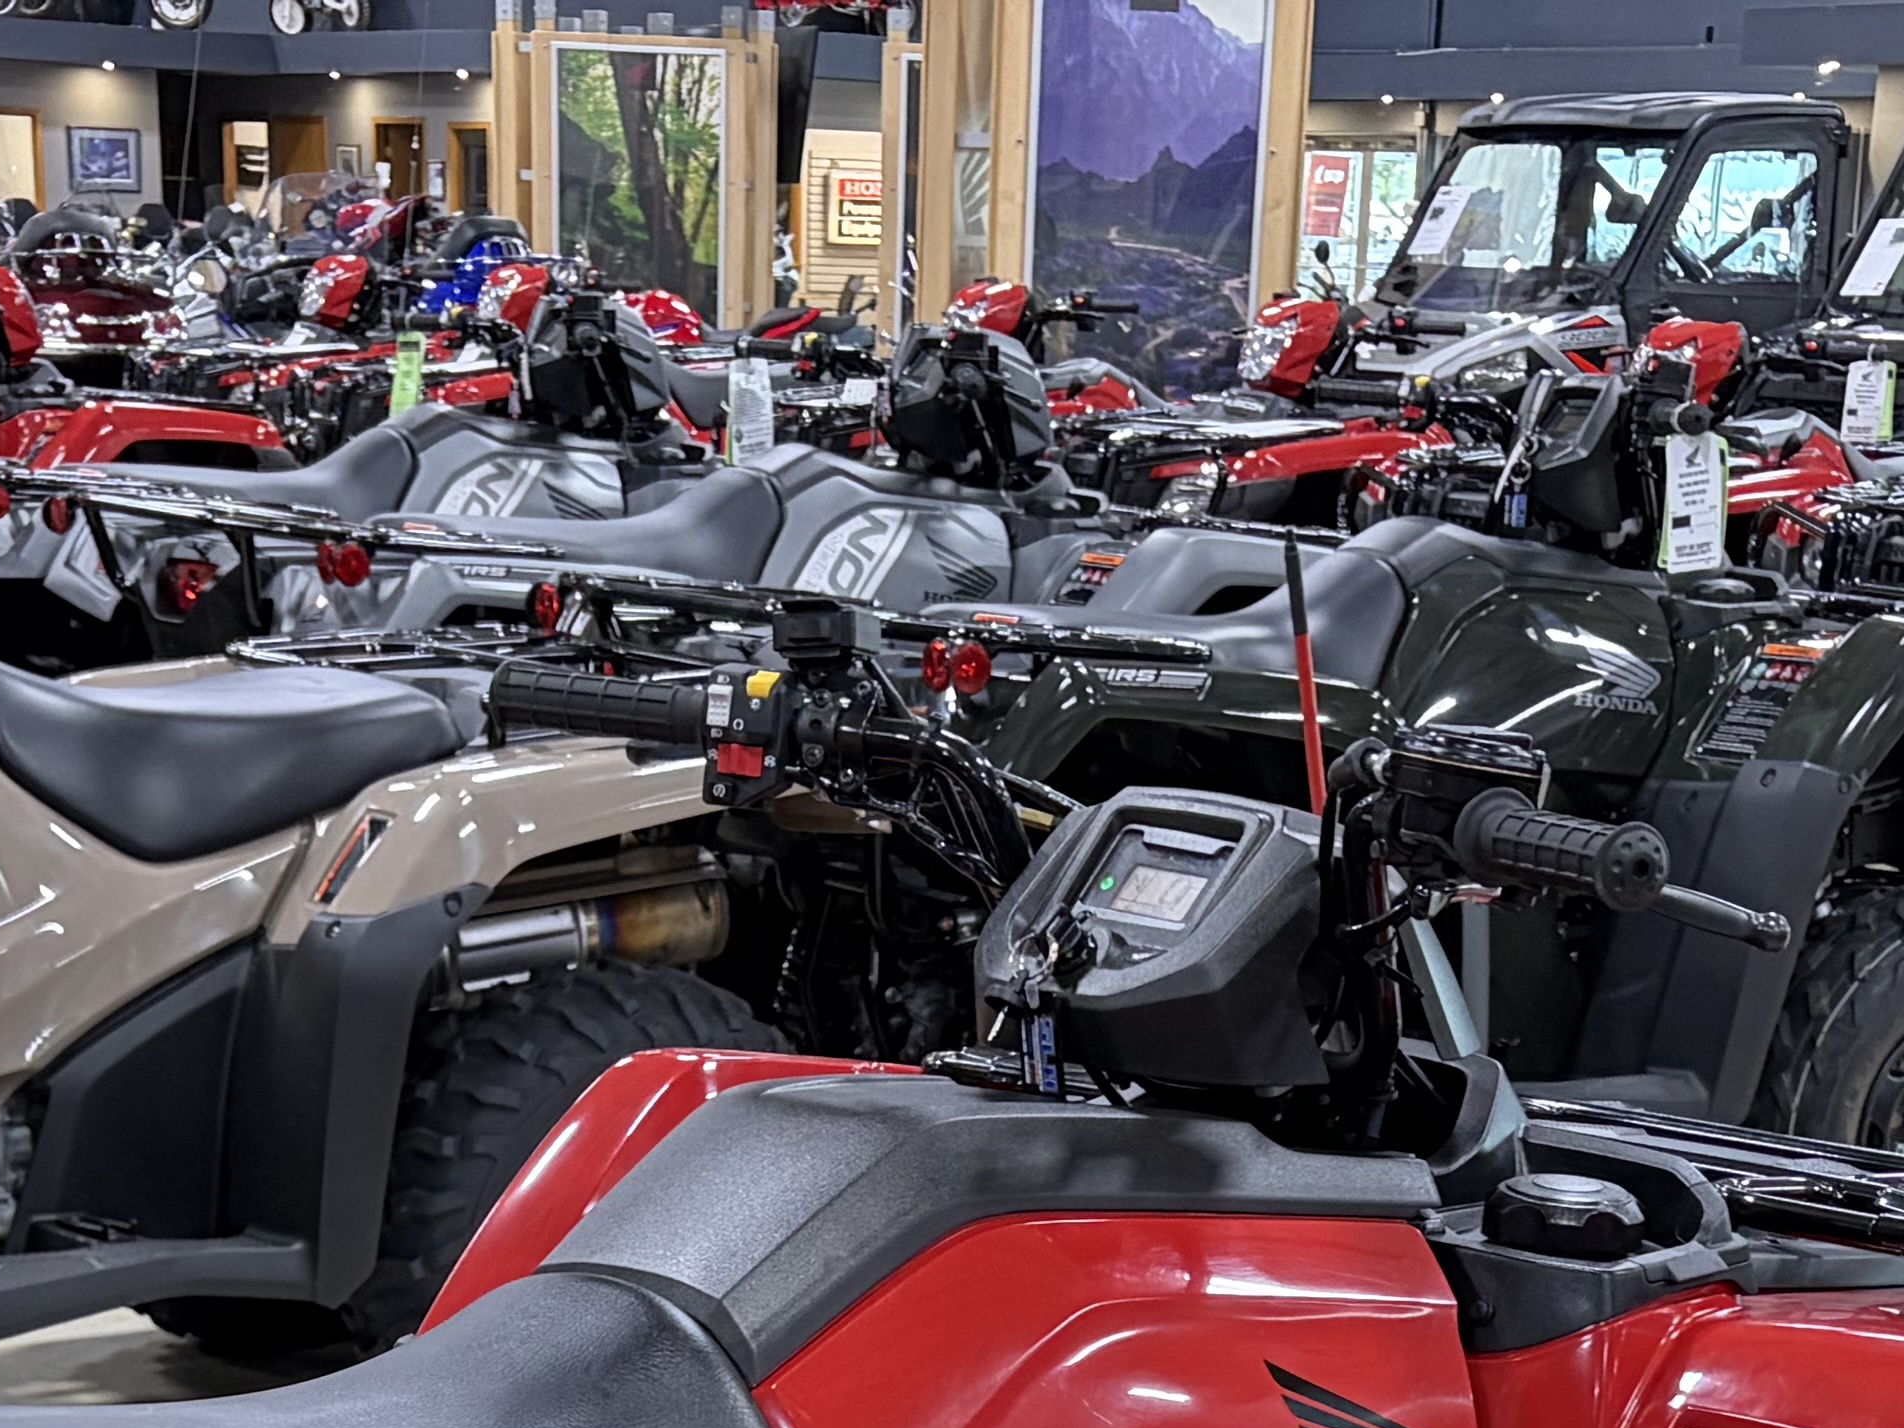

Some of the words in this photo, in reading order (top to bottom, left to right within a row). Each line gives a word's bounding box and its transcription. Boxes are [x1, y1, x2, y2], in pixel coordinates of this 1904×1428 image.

[464, 565, 508, 577] IRS
[1107, 668, 1158, 681] IRS
[1574, 692, 1659, 716] HONDA
